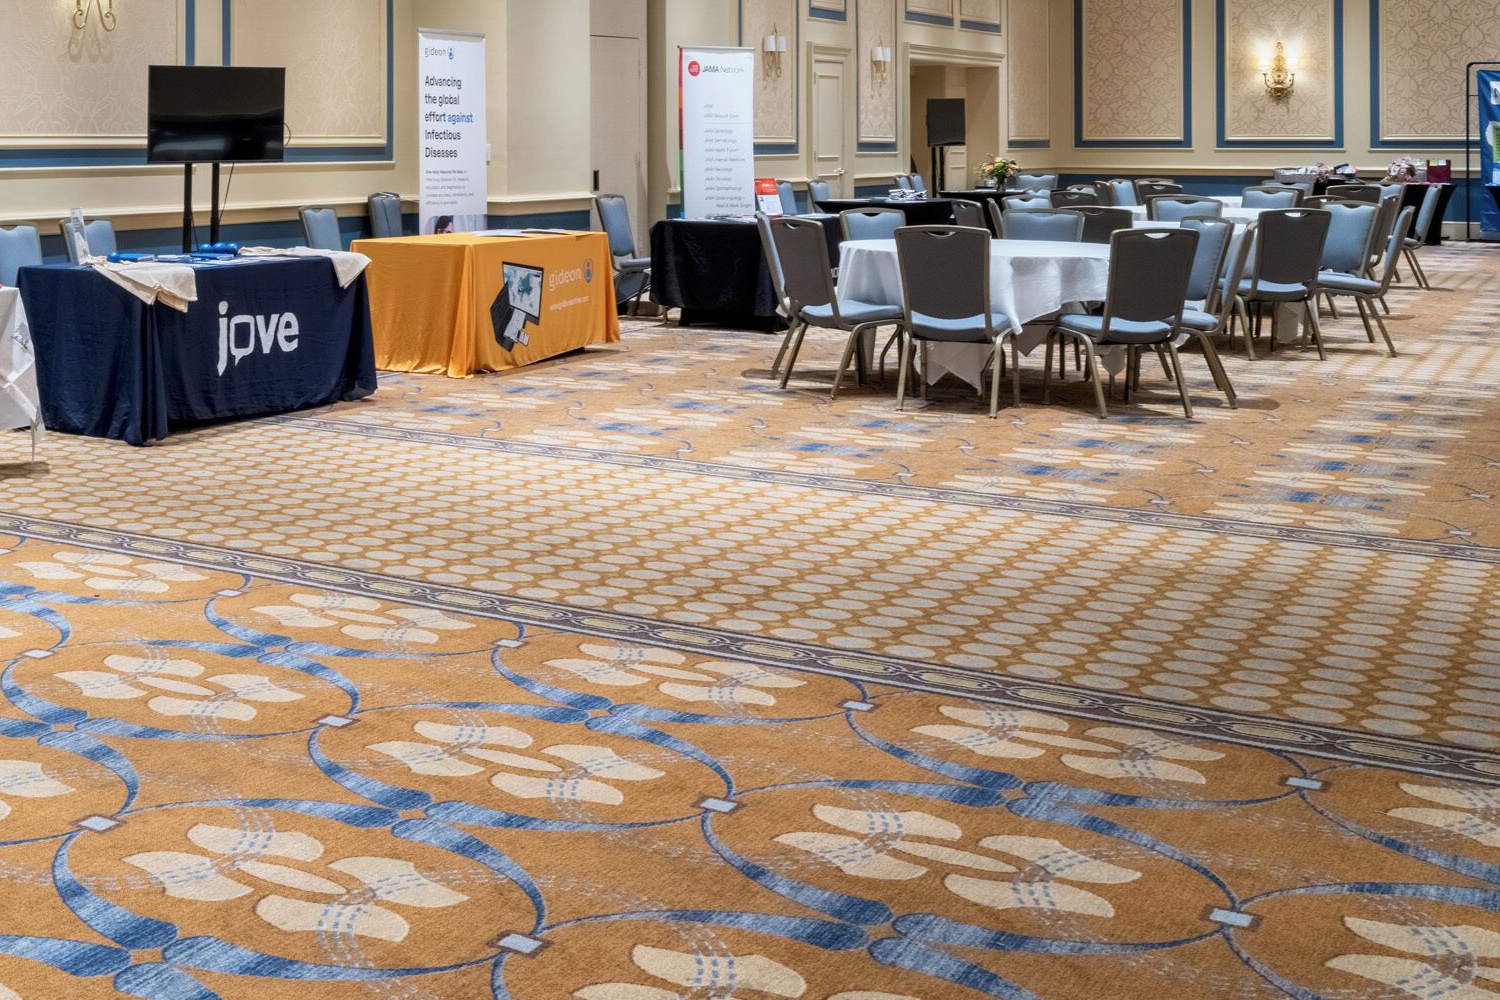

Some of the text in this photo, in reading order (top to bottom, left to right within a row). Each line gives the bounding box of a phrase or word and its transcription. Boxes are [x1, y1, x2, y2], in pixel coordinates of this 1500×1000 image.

[424, 47, 446, 58] gideon
[702, 65, 719, 73] JAMA
[424, 75, 462, 90] Advancing
[424, 93, 460, 107] the global
[424, 111, 474, 125] effort against
[424, 129, 461, 141] Infectious
[424, 146, 458, 159] Diseases
[548, 268, 582, 292] gideon
[217, 300, 300, 377] jove
